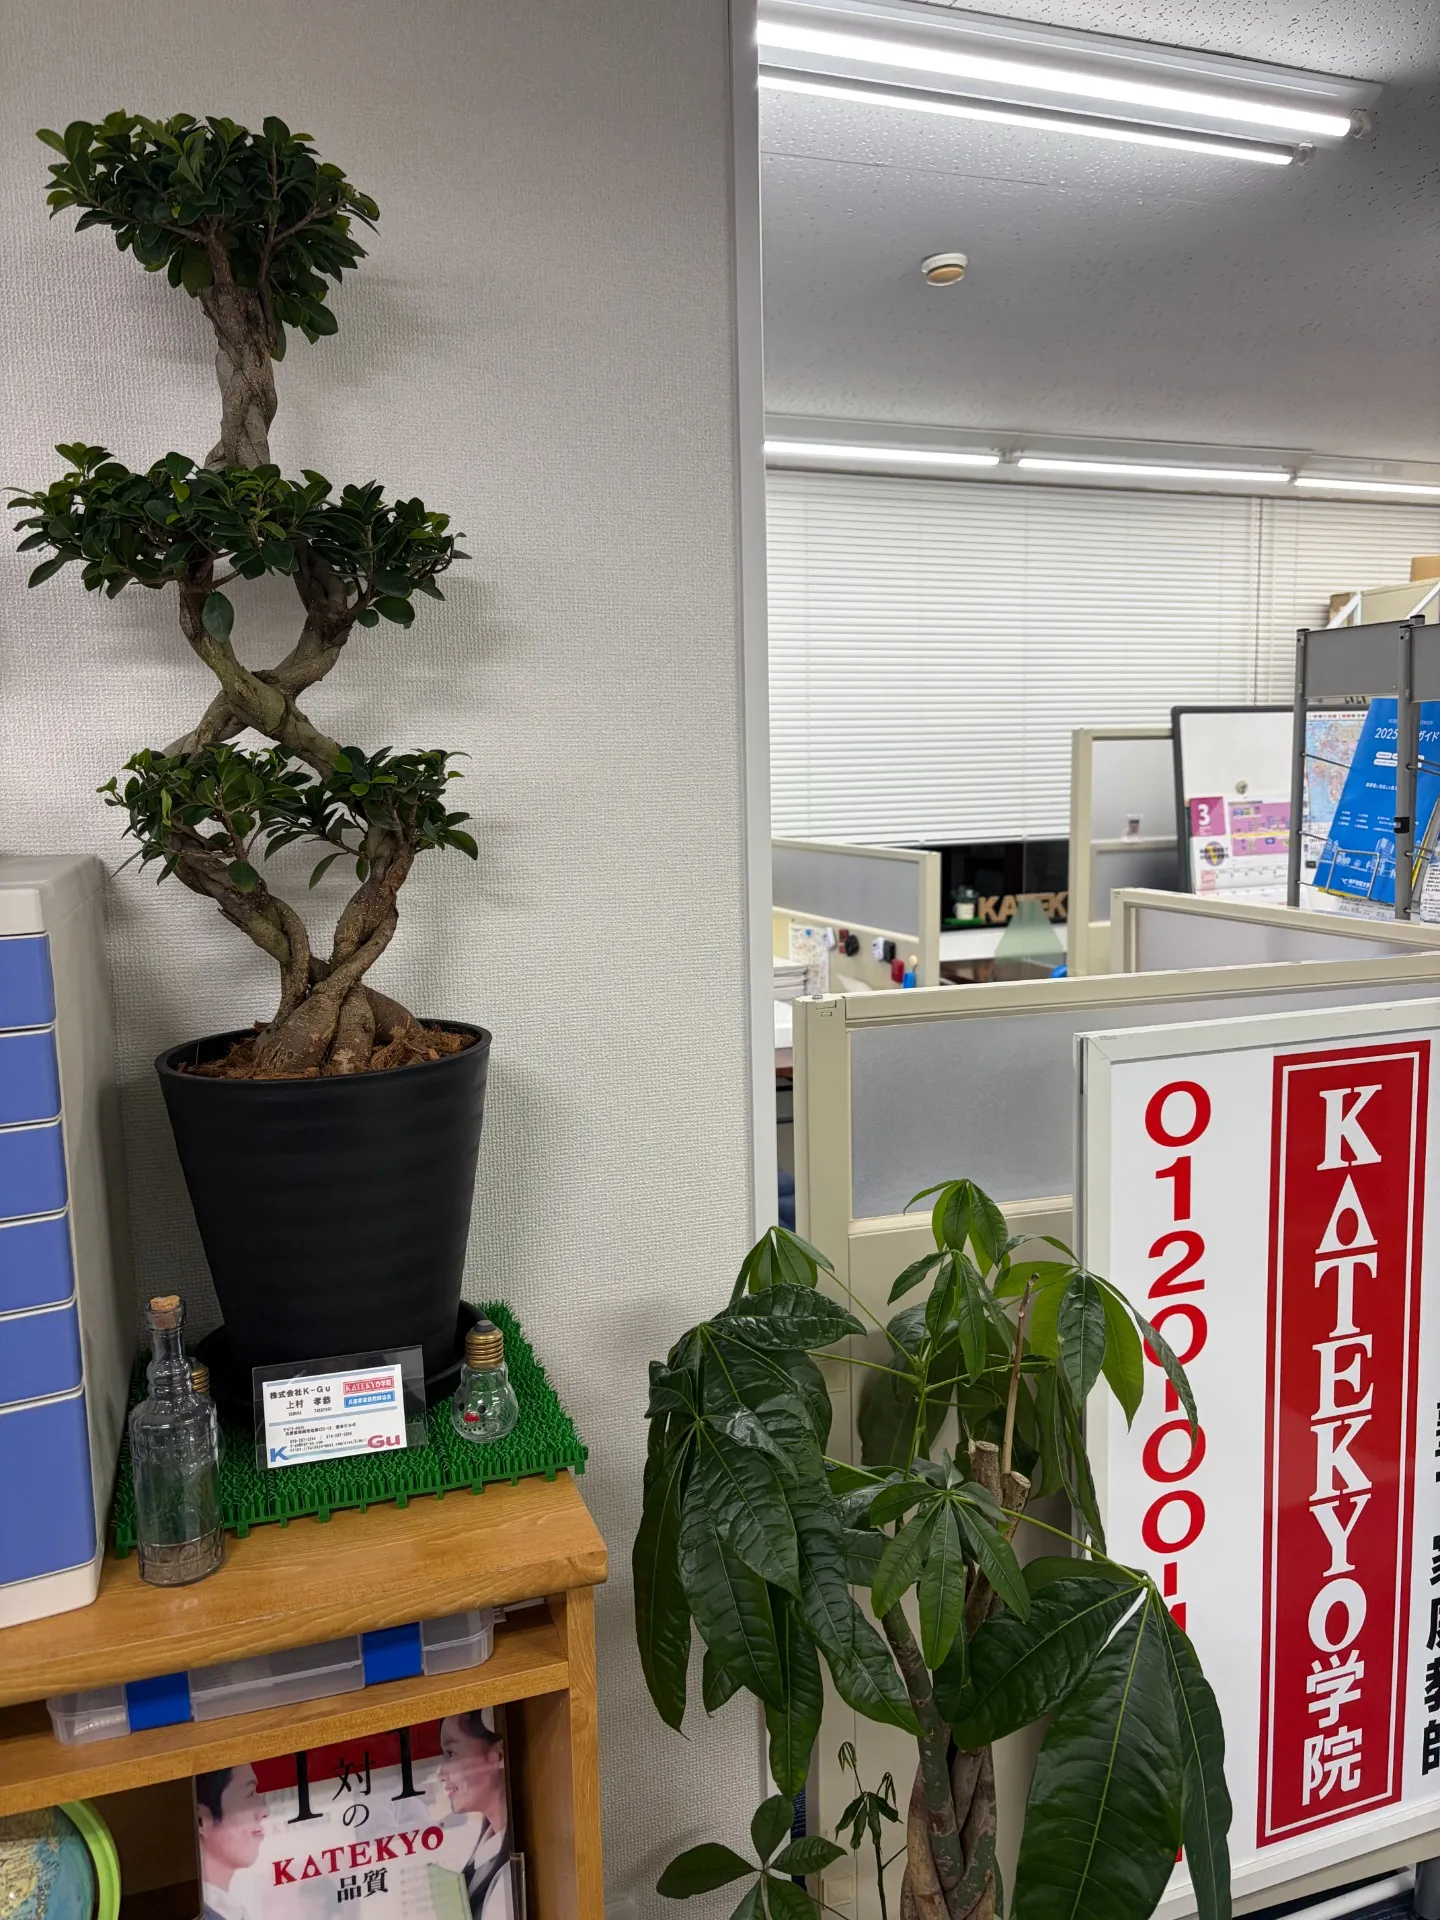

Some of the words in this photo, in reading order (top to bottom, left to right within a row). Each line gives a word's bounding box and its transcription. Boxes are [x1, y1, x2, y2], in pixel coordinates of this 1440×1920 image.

[1197, 803, 1211, 826] 3
[367, 1433, 401, 1449] Gu
[1302, 1083, 1384, 1806] KATEKYO学院
[272, 1825, 444, 1886] KATEKYO
[336, 1867, 389, 1903] 品質
